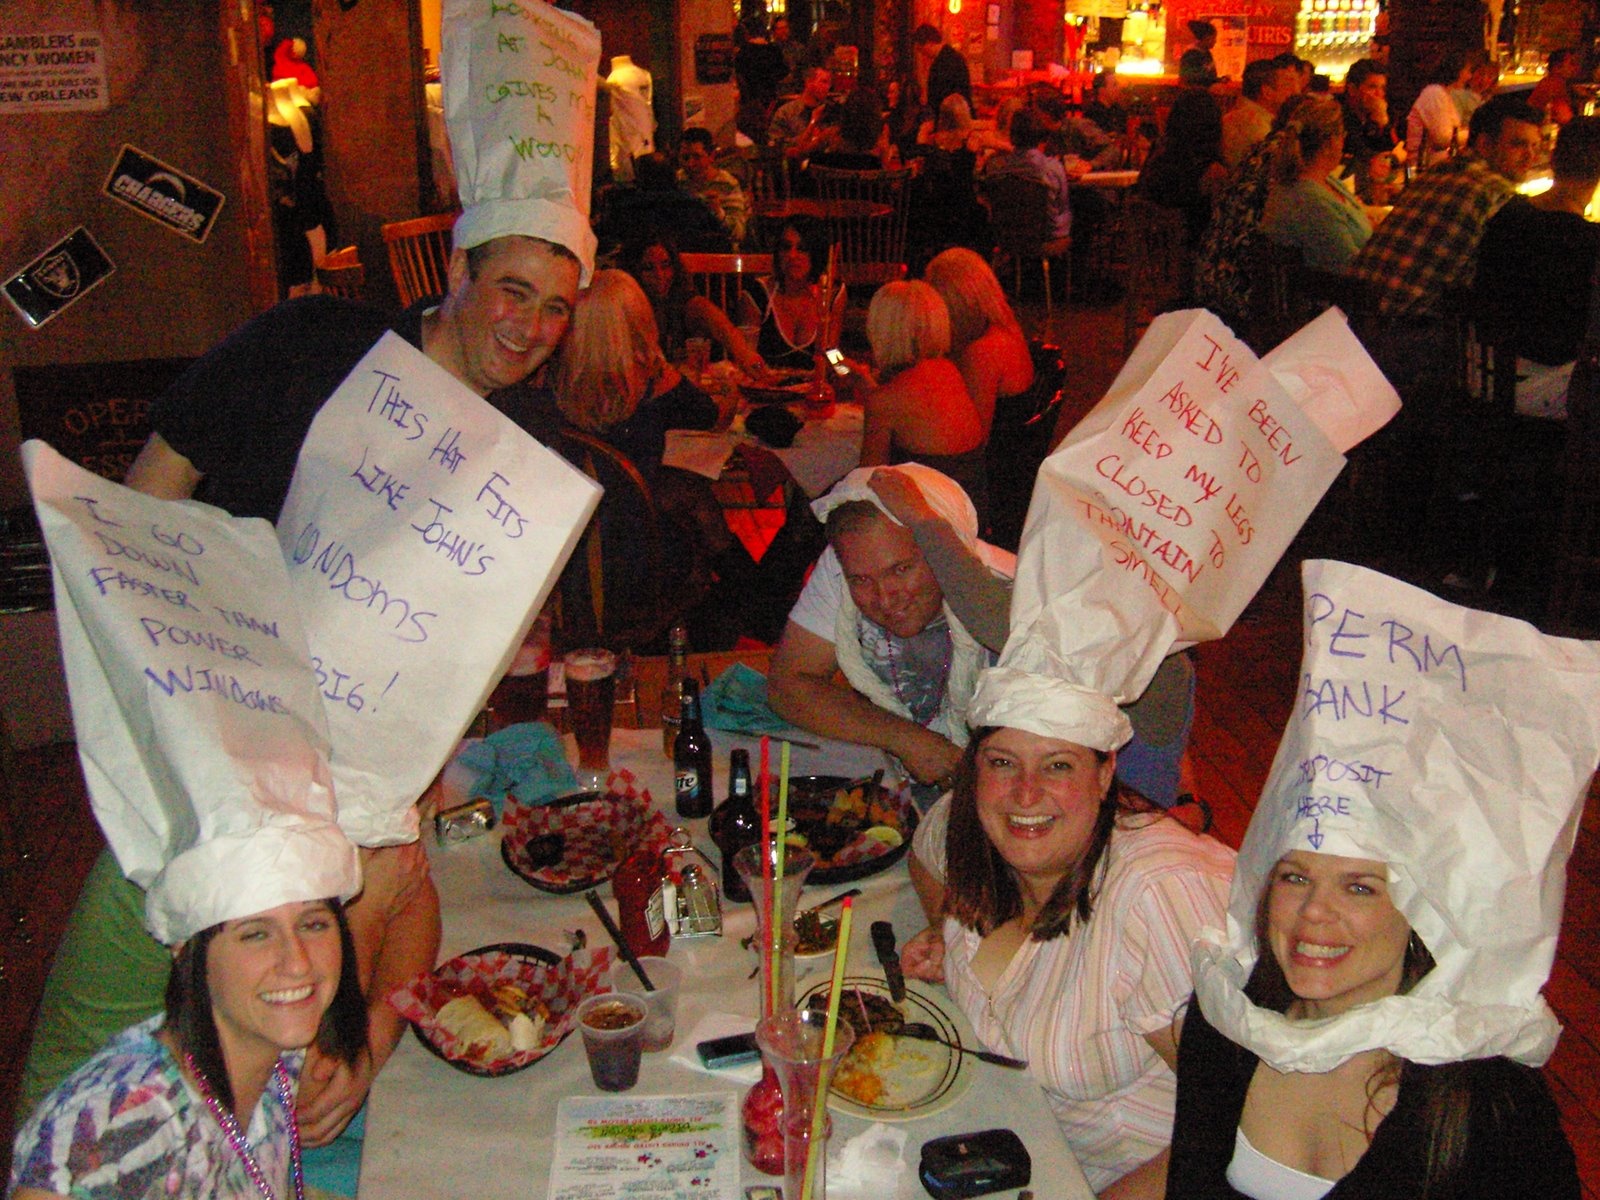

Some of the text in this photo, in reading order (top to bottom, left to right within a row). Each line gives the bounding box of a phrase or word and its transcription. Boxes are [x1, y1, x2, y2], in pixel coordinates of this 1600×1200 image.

[34, 51, 96, 65] WOMEN
[28, 88, 99, 101] ORLEANS
[371, 369, 531, 539] THIS HAT FITS
[1158, 380, 1263, 484] ASKED TO
[1247, 398, 1303, 467] BEEN
[350, 446, 496, 577] LIKE JOHN'S
[1095, 455, 1225, 570] CLOSED TO
[1183, 464, 1225, 504] MY
[1224, 493, 1256, 546] LEGS
[94, 530, 200, 587] DOWN
[150, 524, 205, 556] GO
[139, 616, 264, 668] POWER
[213, 605, 281, 640] THAN
[1307, 592, 1468, 693] PERM
[143, 664, 291, 717] WINDOWS
[1302, 672, 1410, 726] BANK
